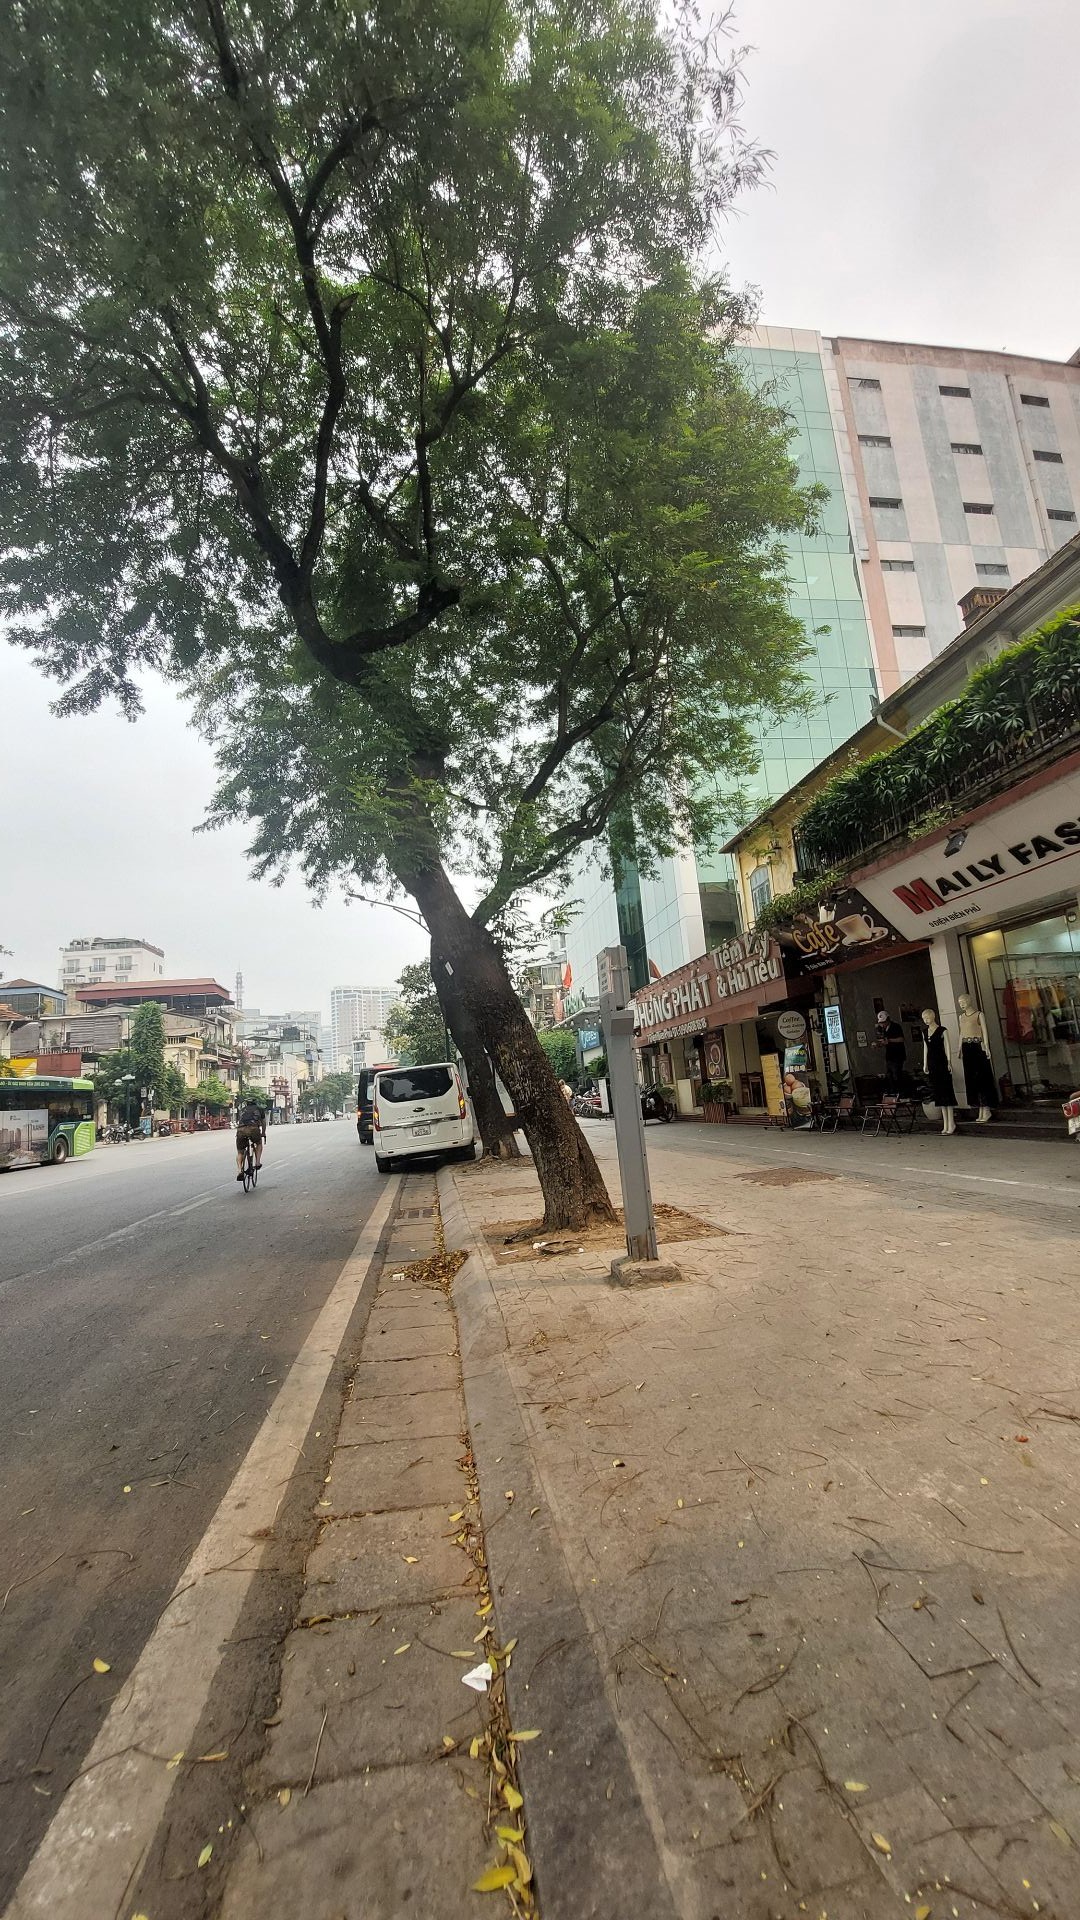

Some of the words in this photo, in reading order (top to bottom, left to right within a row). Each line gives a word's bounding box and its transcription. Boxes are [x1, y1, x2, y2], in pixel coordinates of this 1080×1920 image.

[1008, 816, 1080, 866] FAS
[671, 970, 713, 1017] PHÁT
[716, 974, 728, 998] &
